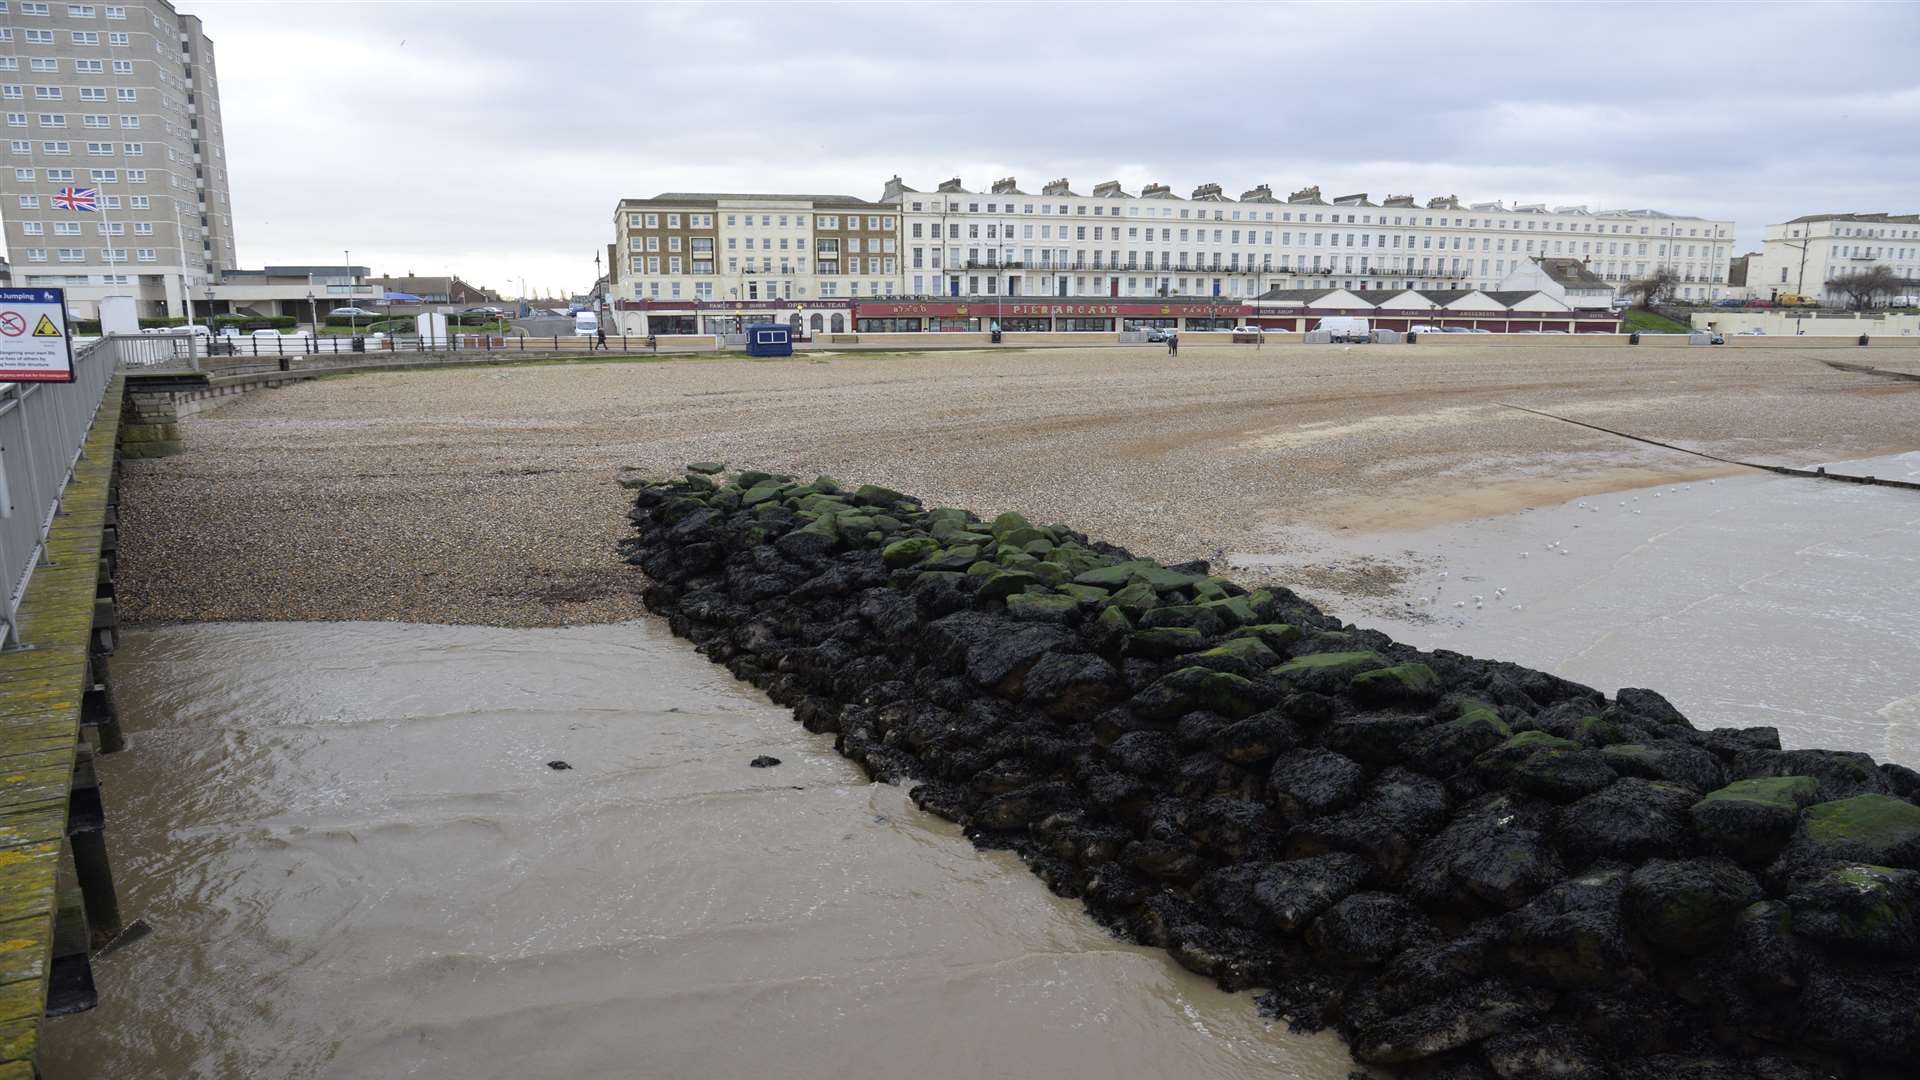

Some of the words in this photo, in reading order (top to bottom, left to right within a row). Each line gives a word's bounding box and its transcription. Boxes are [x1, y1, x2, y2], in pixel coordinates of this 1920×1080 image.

[3, 292, 35, 301] Jumping
[1013, 305, 1048, 314] PIER
[1052, 305, 1118, 314] ARCADE
